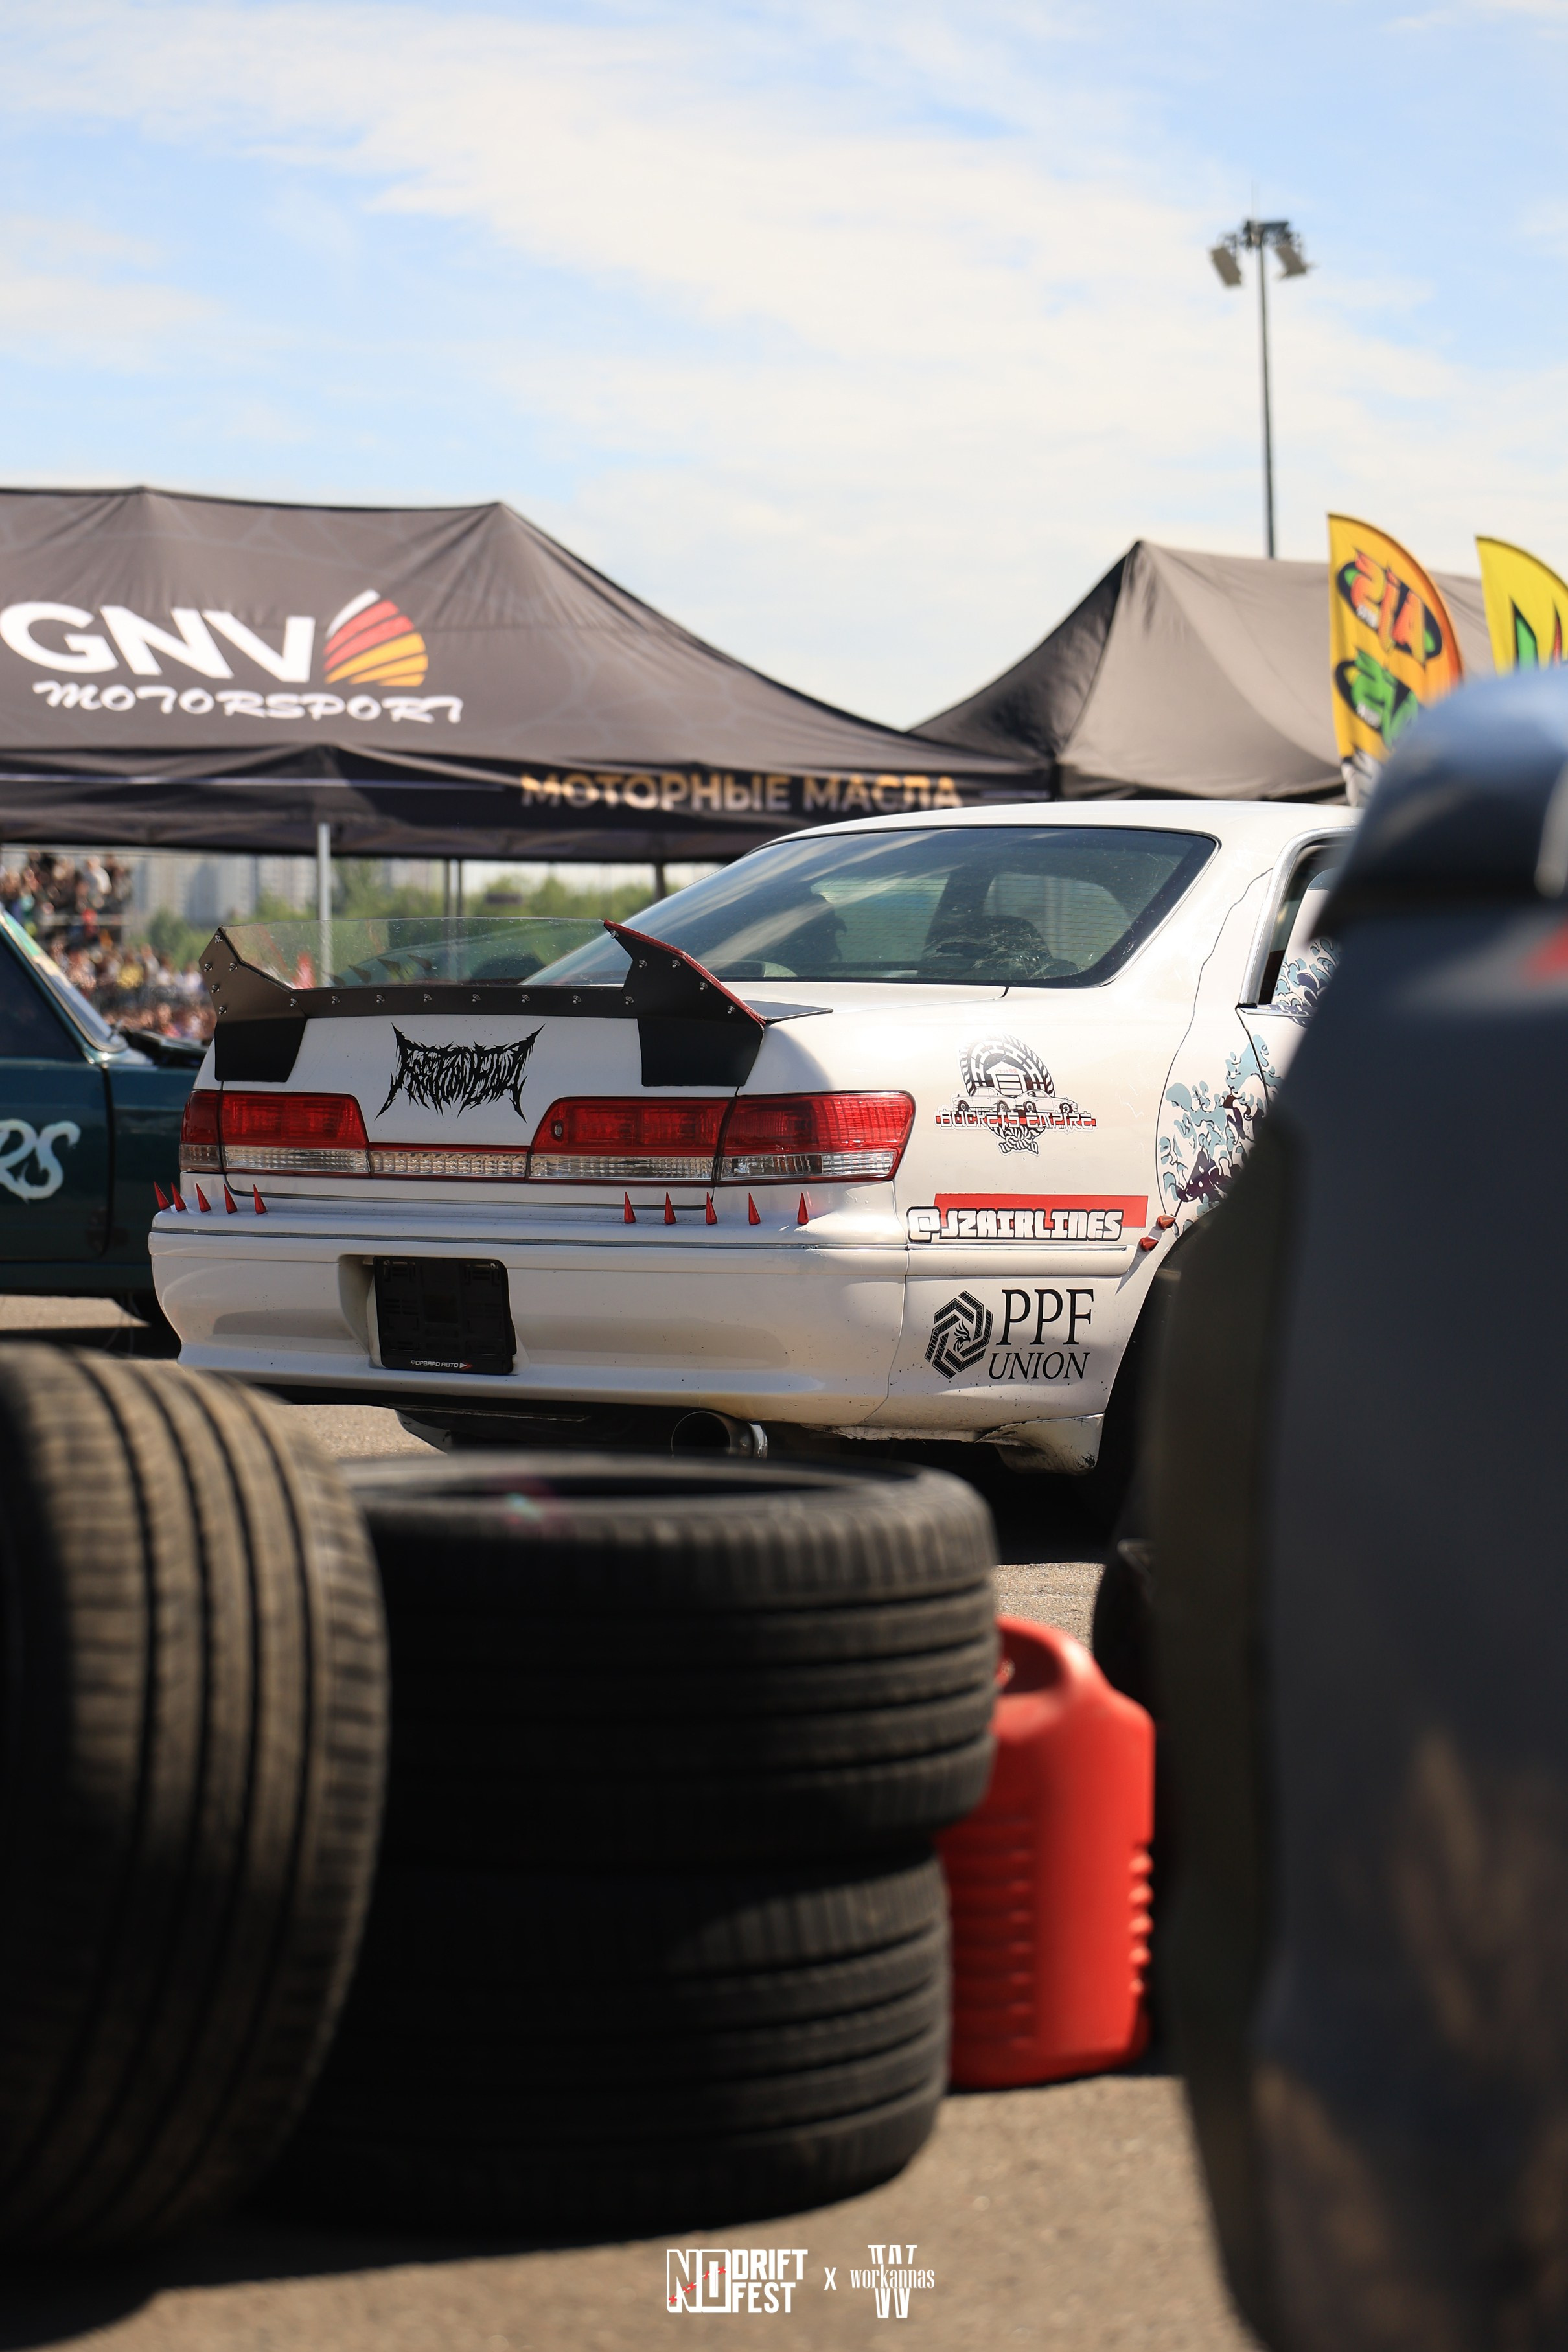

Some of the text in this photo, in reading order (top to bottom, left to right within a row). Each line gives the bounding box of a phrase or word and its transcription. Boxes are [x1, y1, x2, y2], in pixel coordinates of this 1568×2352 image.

[0, 601, 316, 684] GNV
[32, 680, 463, 724] MOTORSPORT
[520, 772, 792, 812] МОТОРНЫЕ
[939, 1107, 1094, 1132] BUCKETS EMPIRE
[996, 1289, 1094, 1346] PPF
[989, 1352, 1089, 1379] UNION
